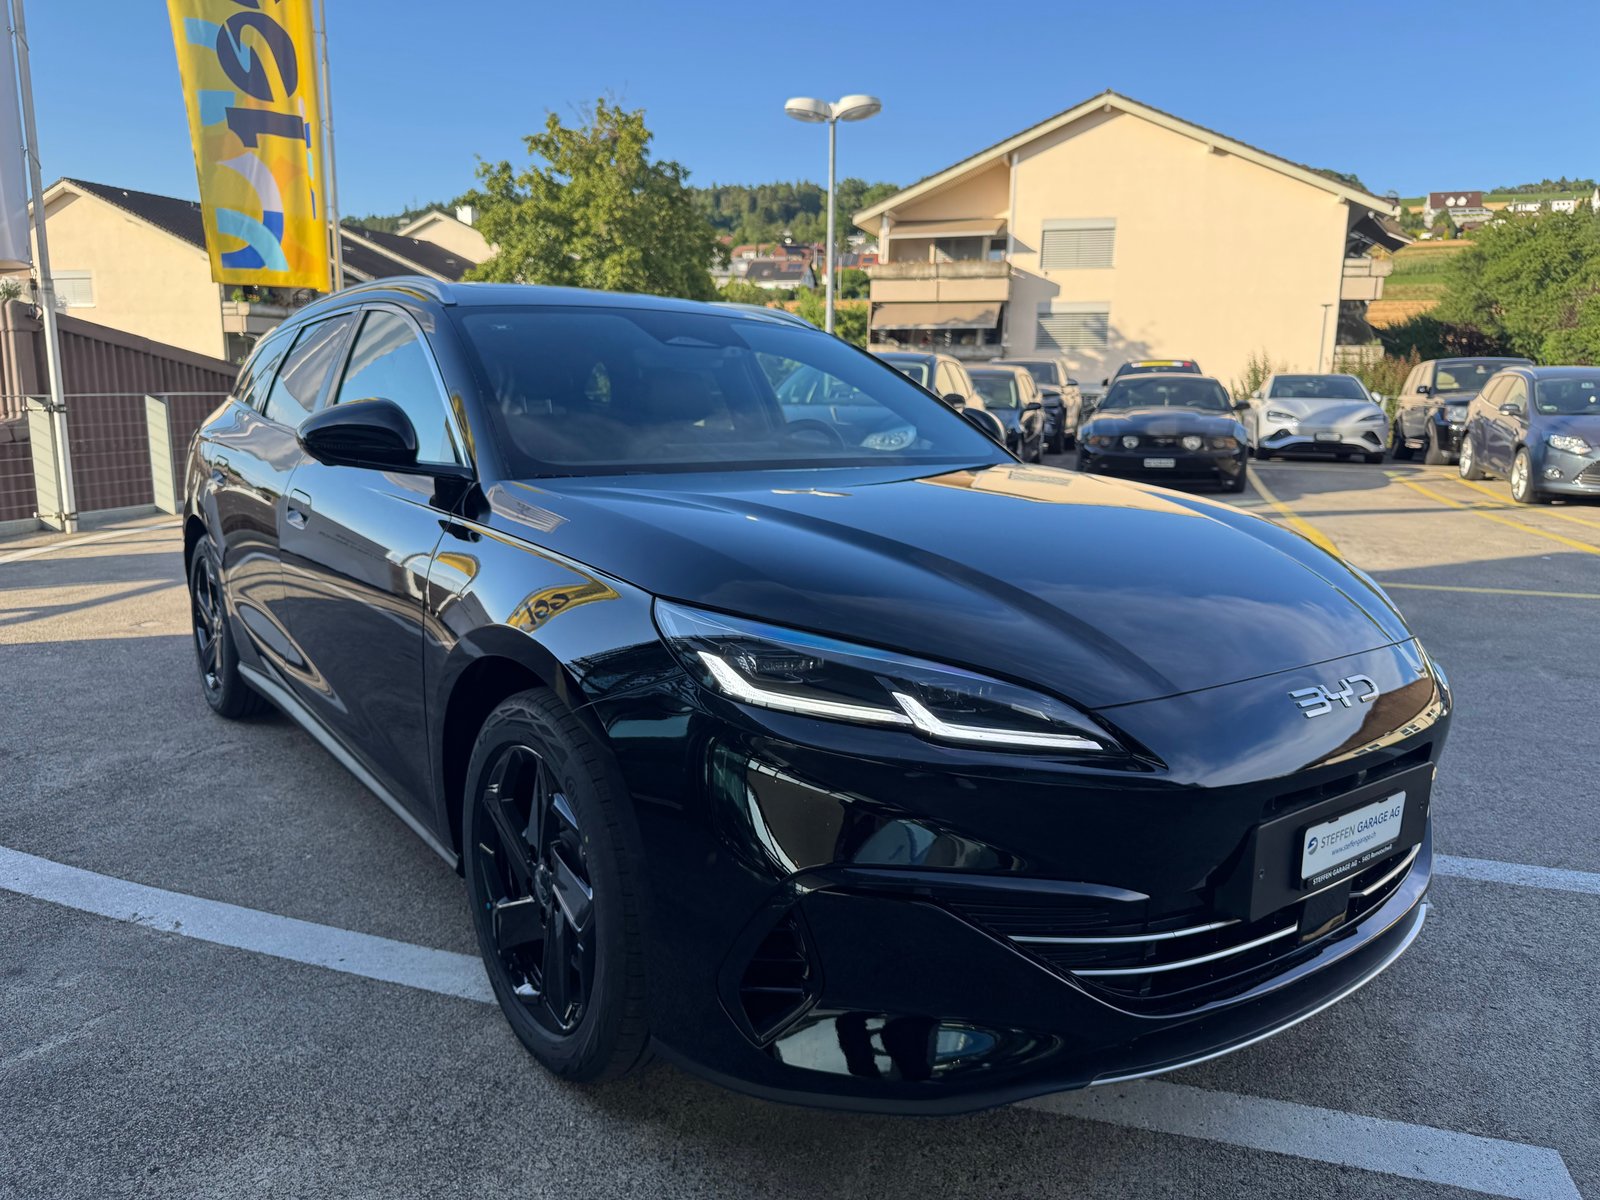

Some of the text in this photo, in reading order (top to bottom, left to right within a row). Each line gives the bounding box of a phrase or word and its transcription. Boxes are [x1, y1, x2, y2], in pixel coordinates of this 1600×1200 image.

[1288, 674, 1379, 718] BYD
[1320, 805, 1400, 848] STEFFEN GARAGE AG
[1331, 831, 1376, 855] www.steffengarage.ch
[1312, 873, 1333, 885] STEFFEN
[1332, 863, 1352, 876] GARAGE
[1350, 859, 1358, 869] AG
